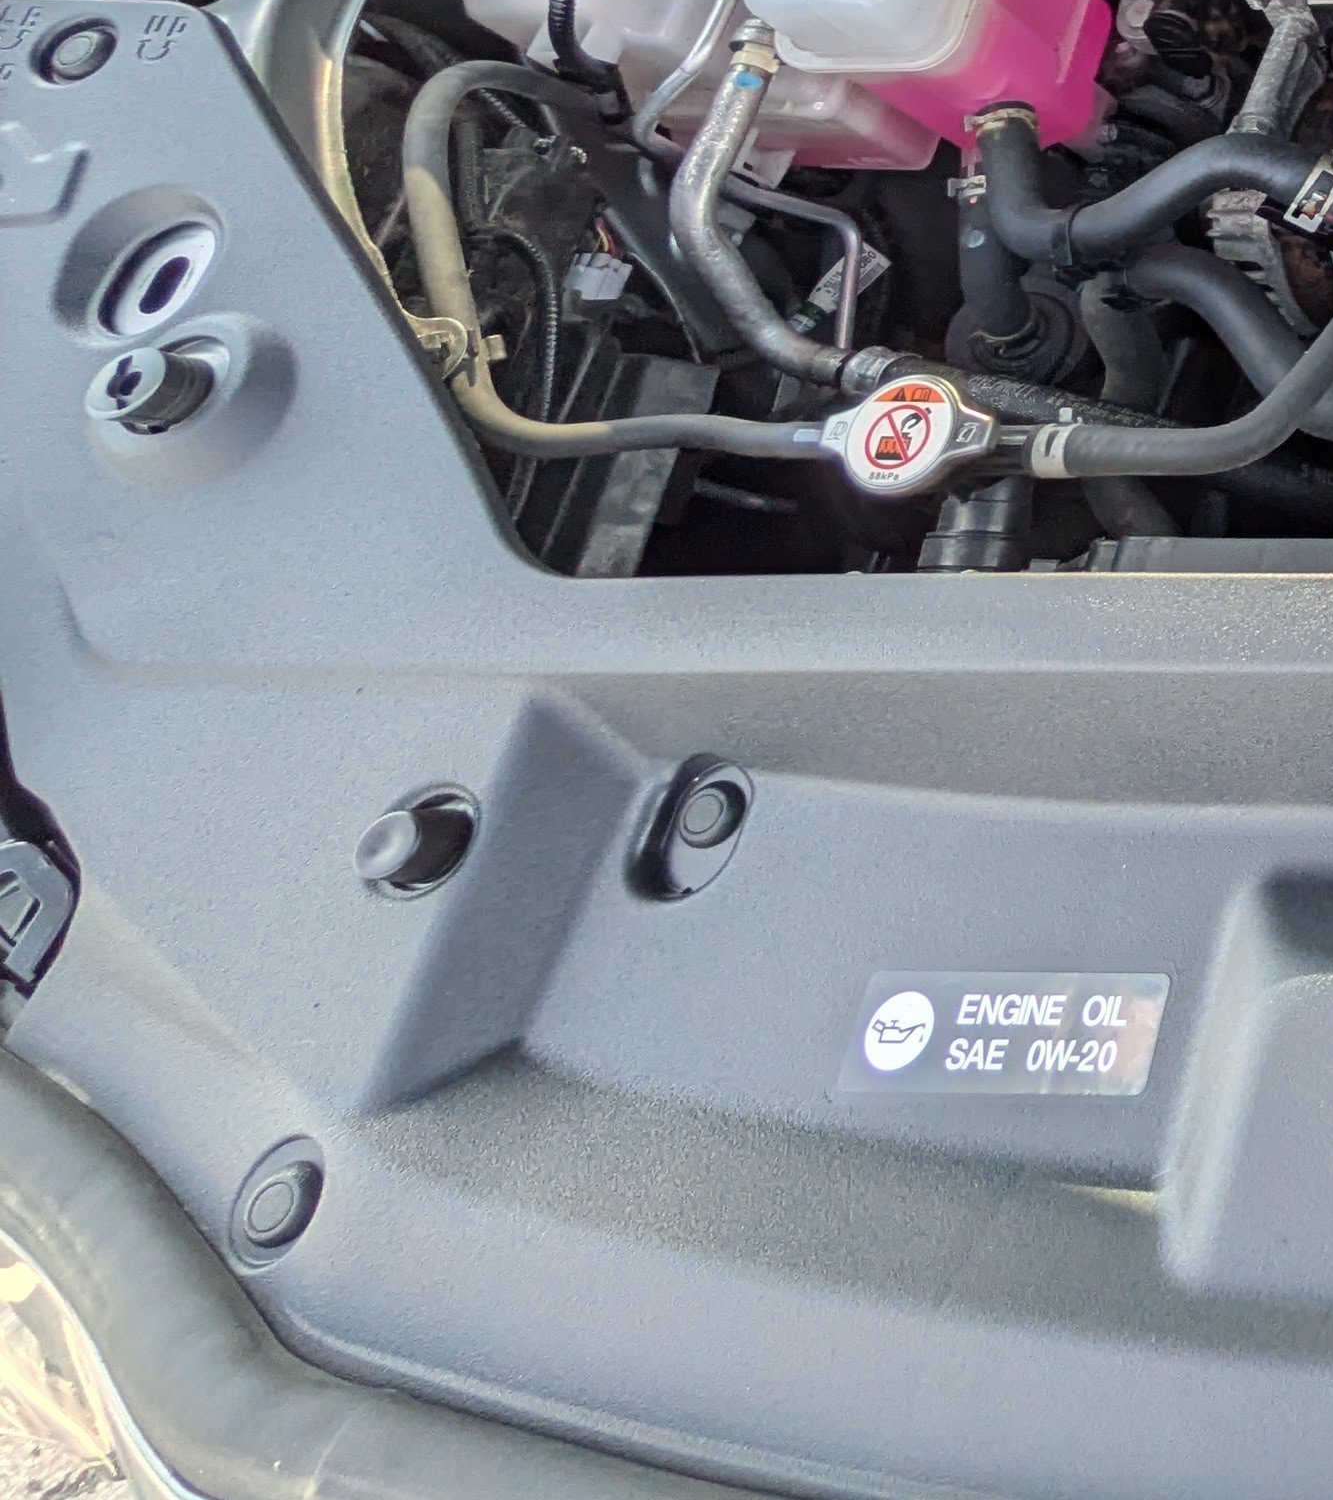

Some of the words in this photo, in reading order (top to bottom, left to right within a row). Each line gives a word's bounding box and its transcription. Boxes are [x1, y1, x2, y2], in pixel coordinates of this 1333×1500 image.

[869, 471, 900, 481] 88kPa
[956, 993, 1067, 1026] ENGINE
[1083, 995, 1128, 1027] OIL
[945, 1038, 1009, 1071] SAE
[1026, 1039, 1118, 1073] 0W-20
